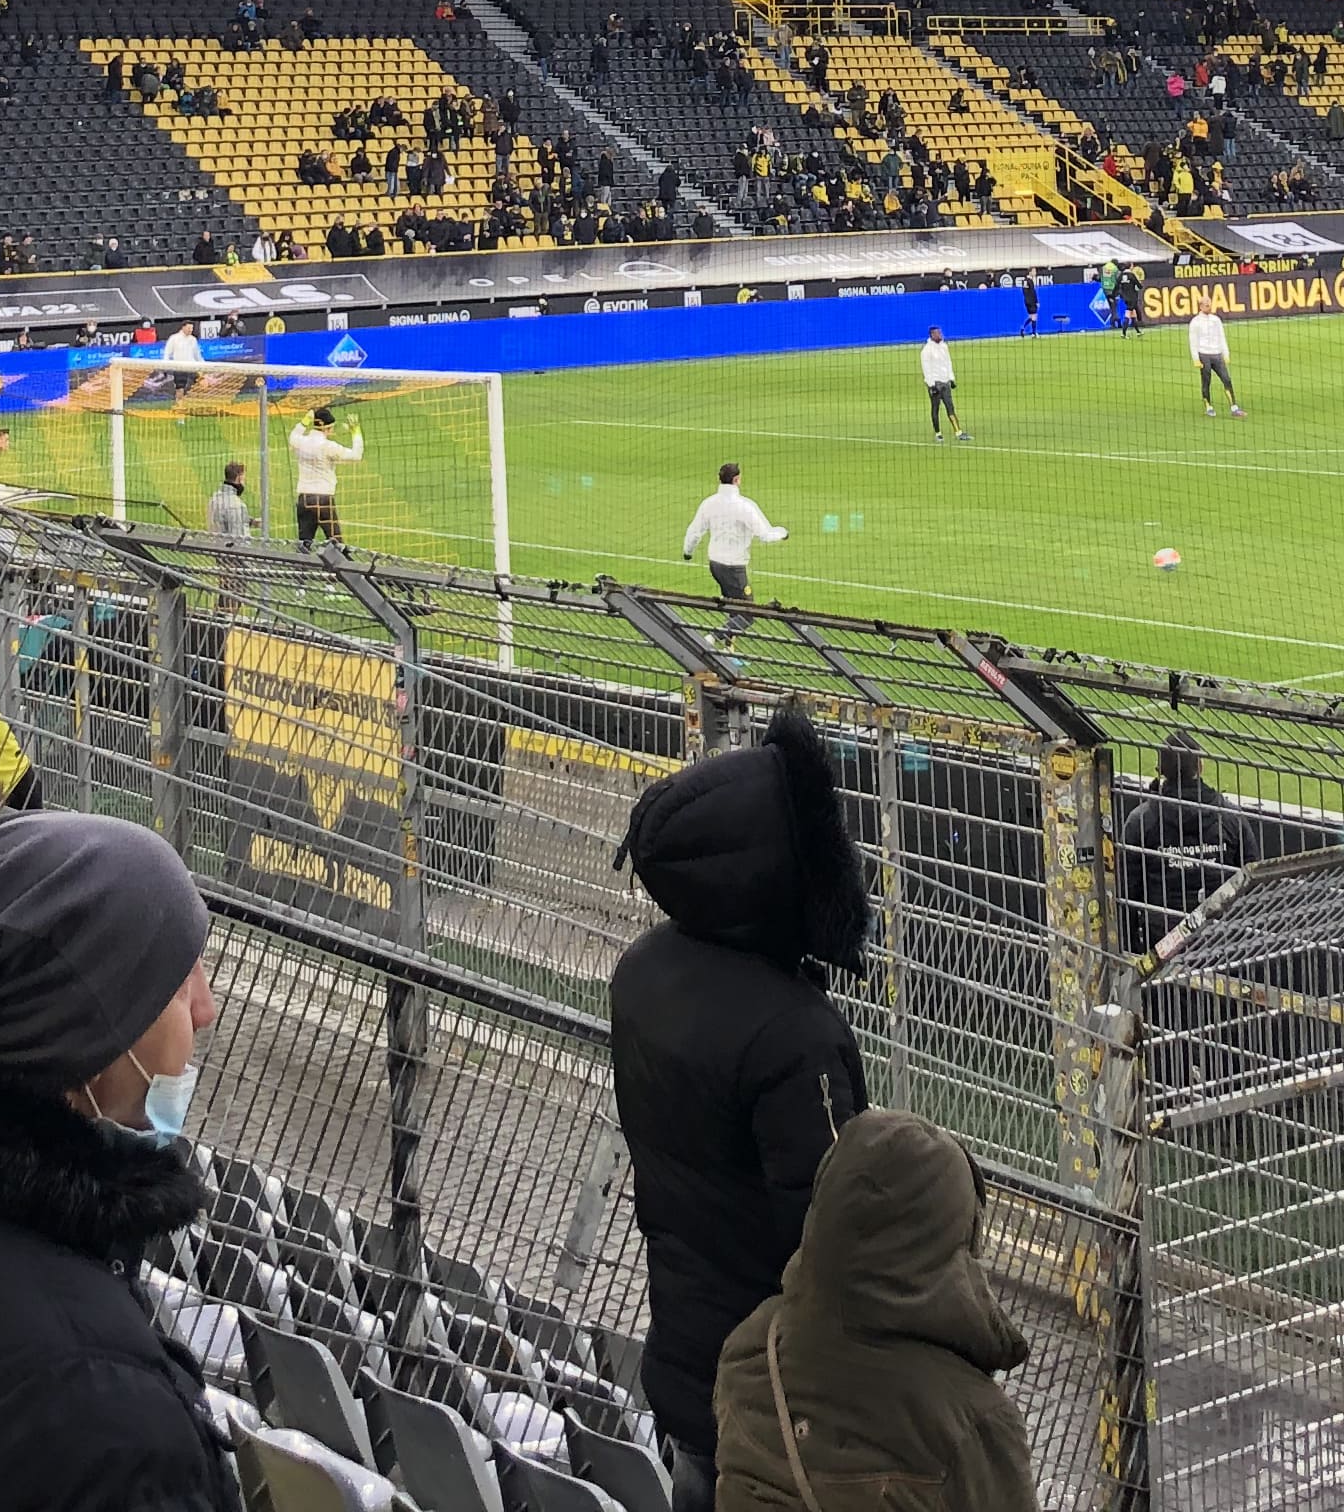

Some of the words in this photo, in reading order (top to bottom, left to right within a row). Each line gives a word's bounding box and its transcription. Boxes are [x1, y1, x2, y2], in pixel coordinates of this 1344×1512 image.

[1174, 262, 1240, 280] BORUSSIA
[469, 272, 605, 287] OPEL
[193, 284, 354, 309] GLS.
[838, 286, 870, 298] SIGNAL
[870, 284, 896, 296] IDUNA
[1143, 282, 1245, 319] SIGNAL
[1250, 276, 1332, 312] IDUNA
[602, 298, 649, 312] EVONIK
[389, 315, 426, 327] SIGNAL
[427, 313, 459, 326] IDUNA
[334, 350, 362, 362] ARAL
